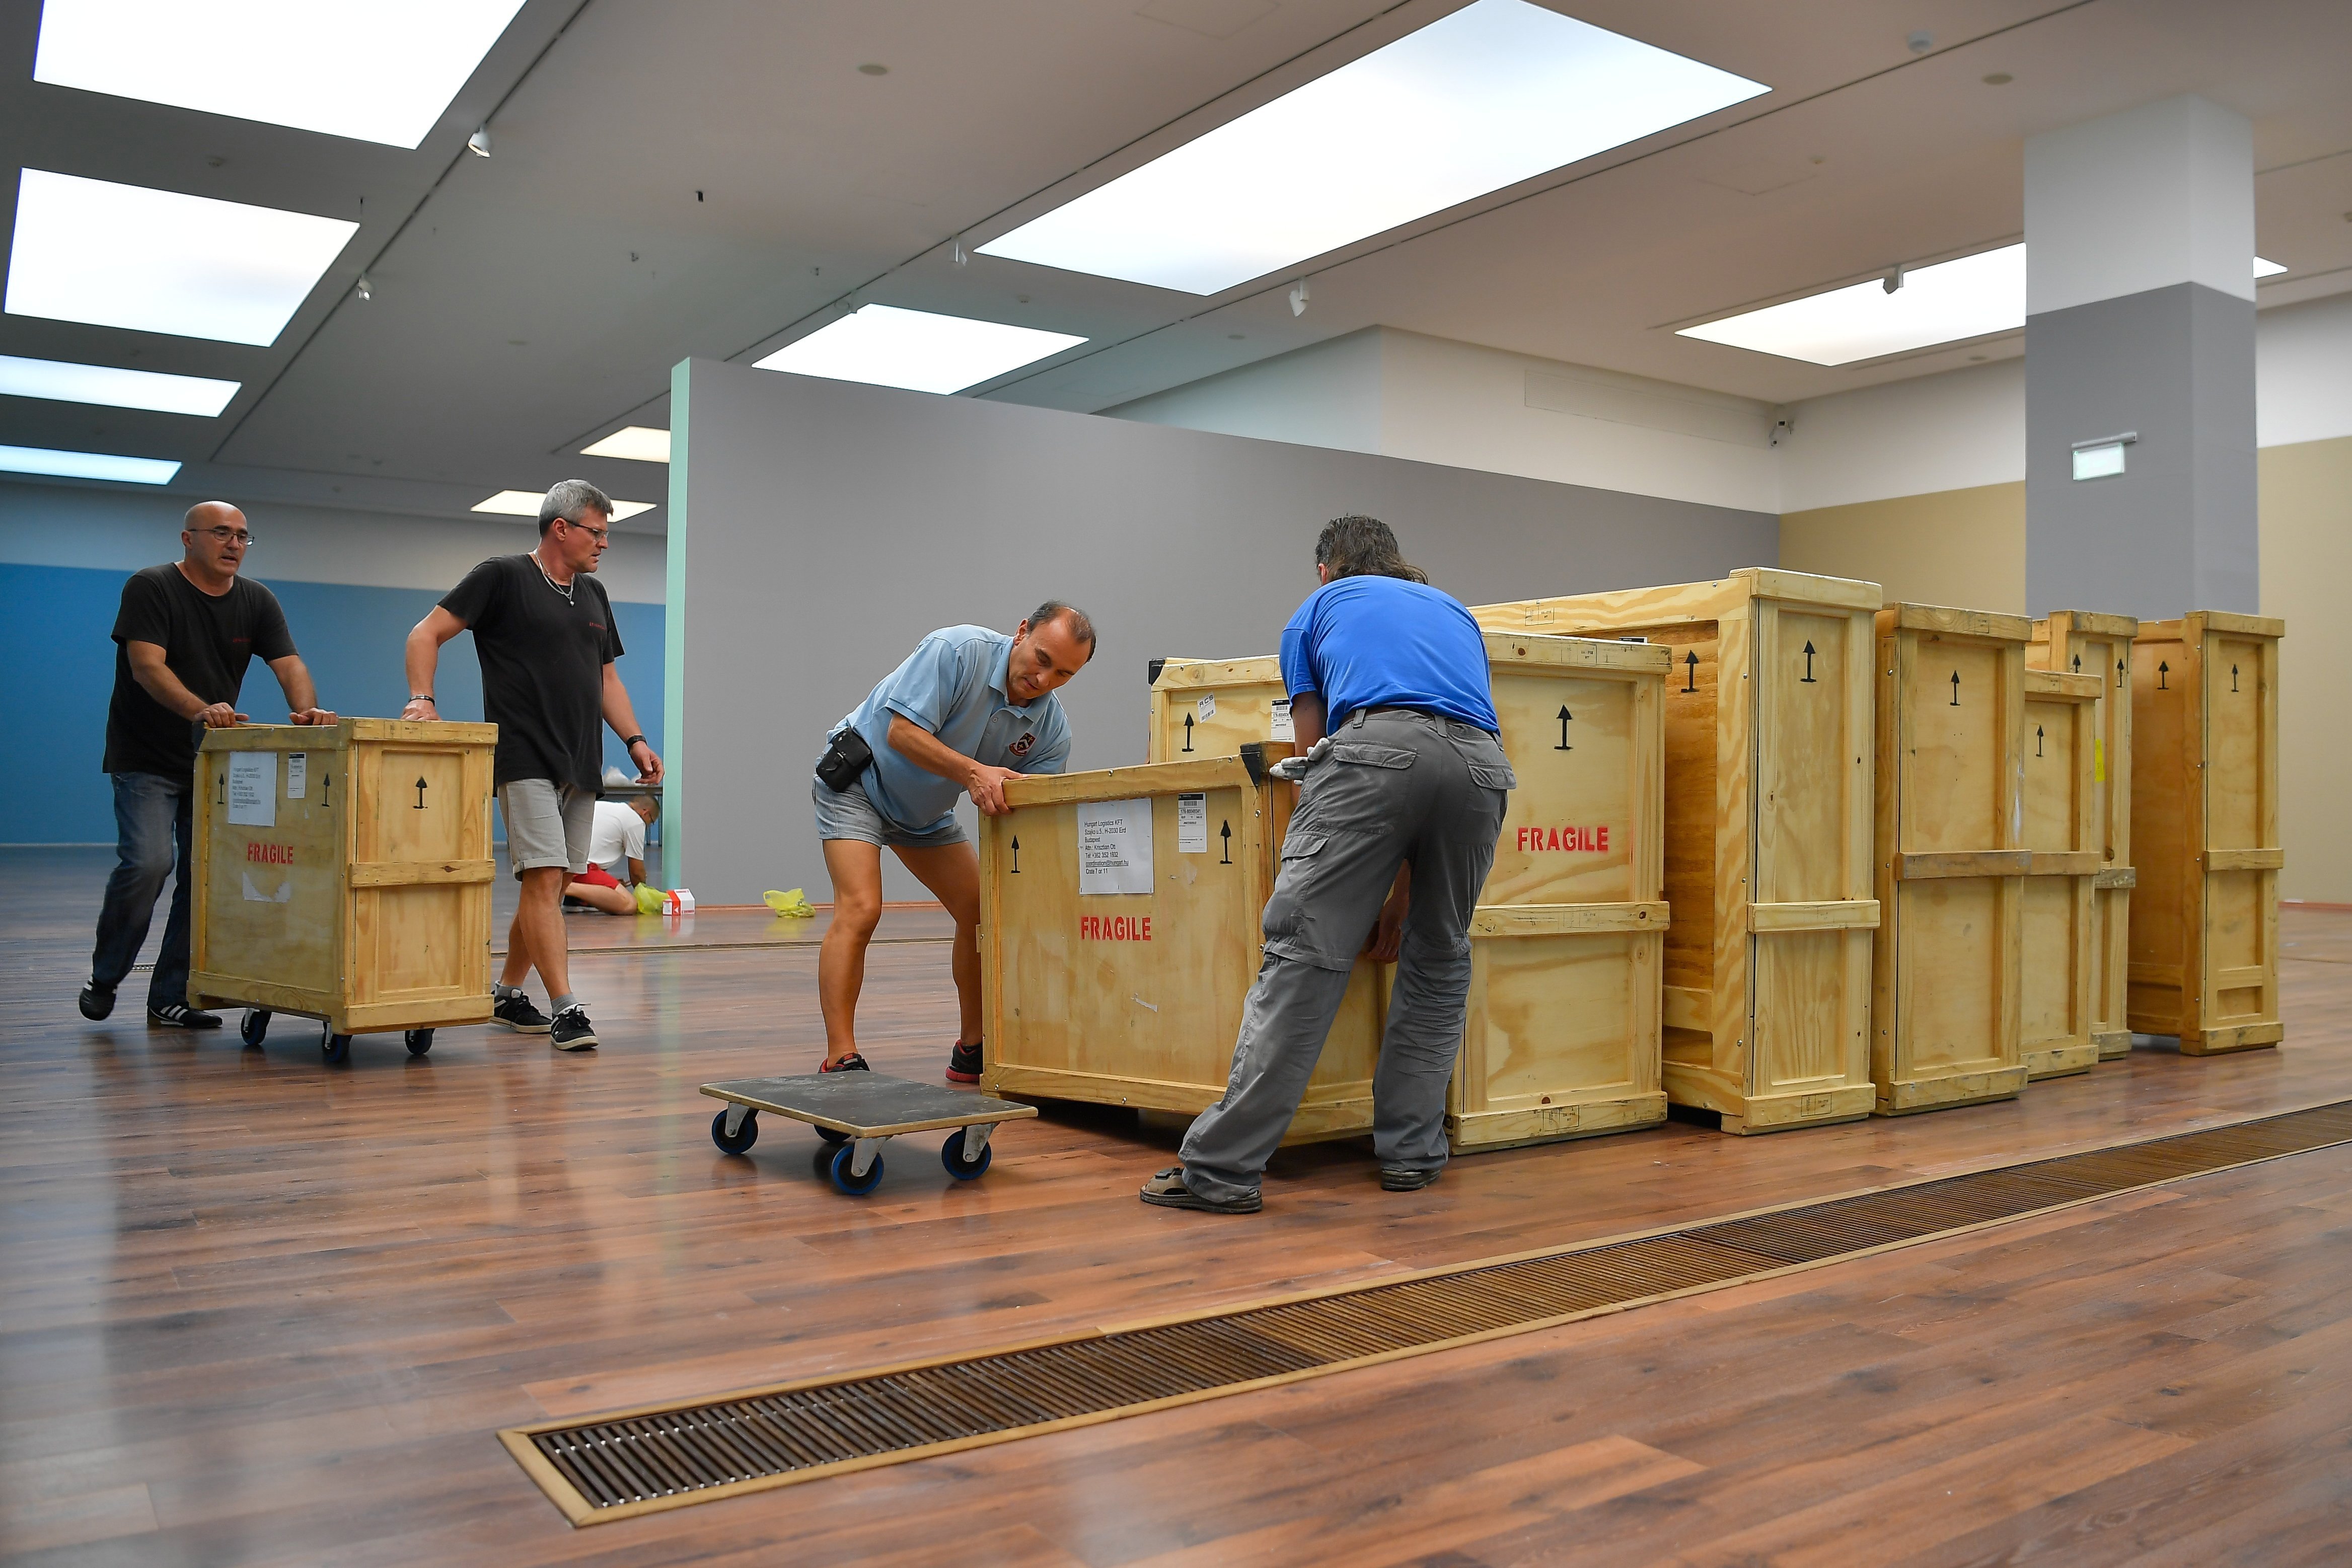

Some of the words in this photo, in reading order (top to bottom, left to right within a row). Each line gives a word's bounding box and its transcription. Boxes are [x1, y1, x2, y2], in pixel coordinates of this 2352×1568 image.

[1199, 695, 1213, 708] ACS
[1517, 827, 1608, 852] FRAGILE
[248, 843, 293, 864] FRAGILE
[1080, 916, 1152, 941] FRAGILE
